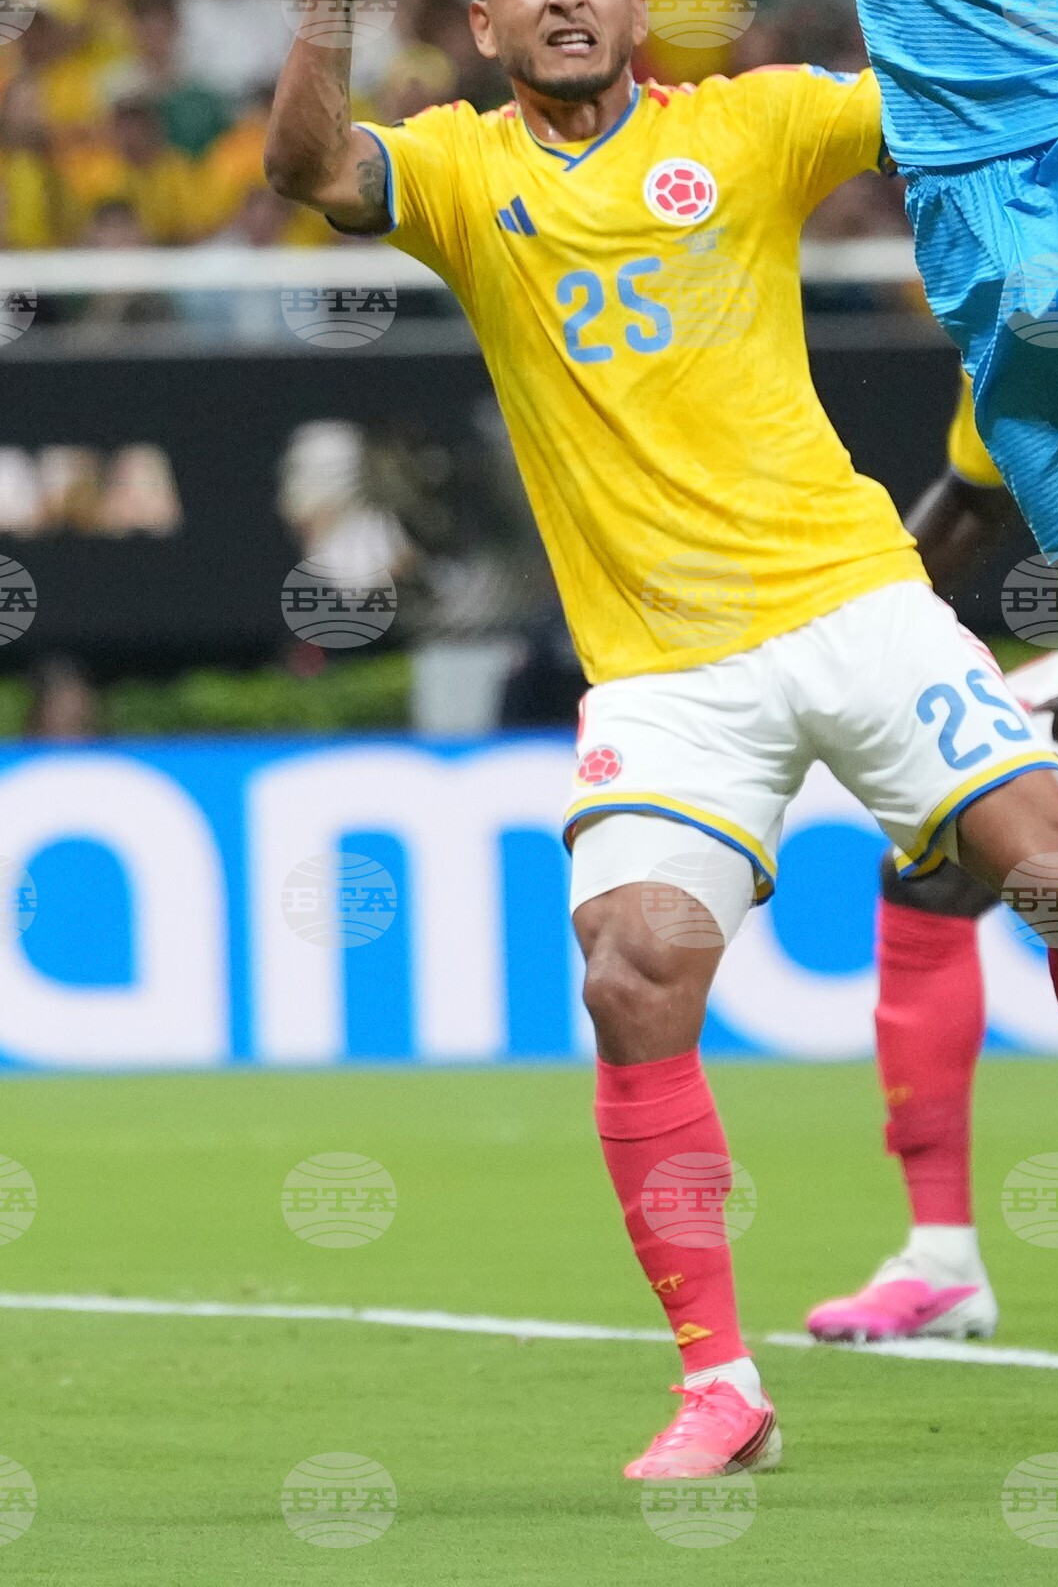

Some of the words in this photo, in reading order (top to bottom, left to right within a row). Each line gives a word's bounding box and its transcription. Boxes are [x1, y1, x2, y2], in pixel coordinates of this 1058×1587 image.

[557, 257, 673, 365] 25
[916, 669, 1033, 770] 25
[649, 1274, 685, 1294] CF
